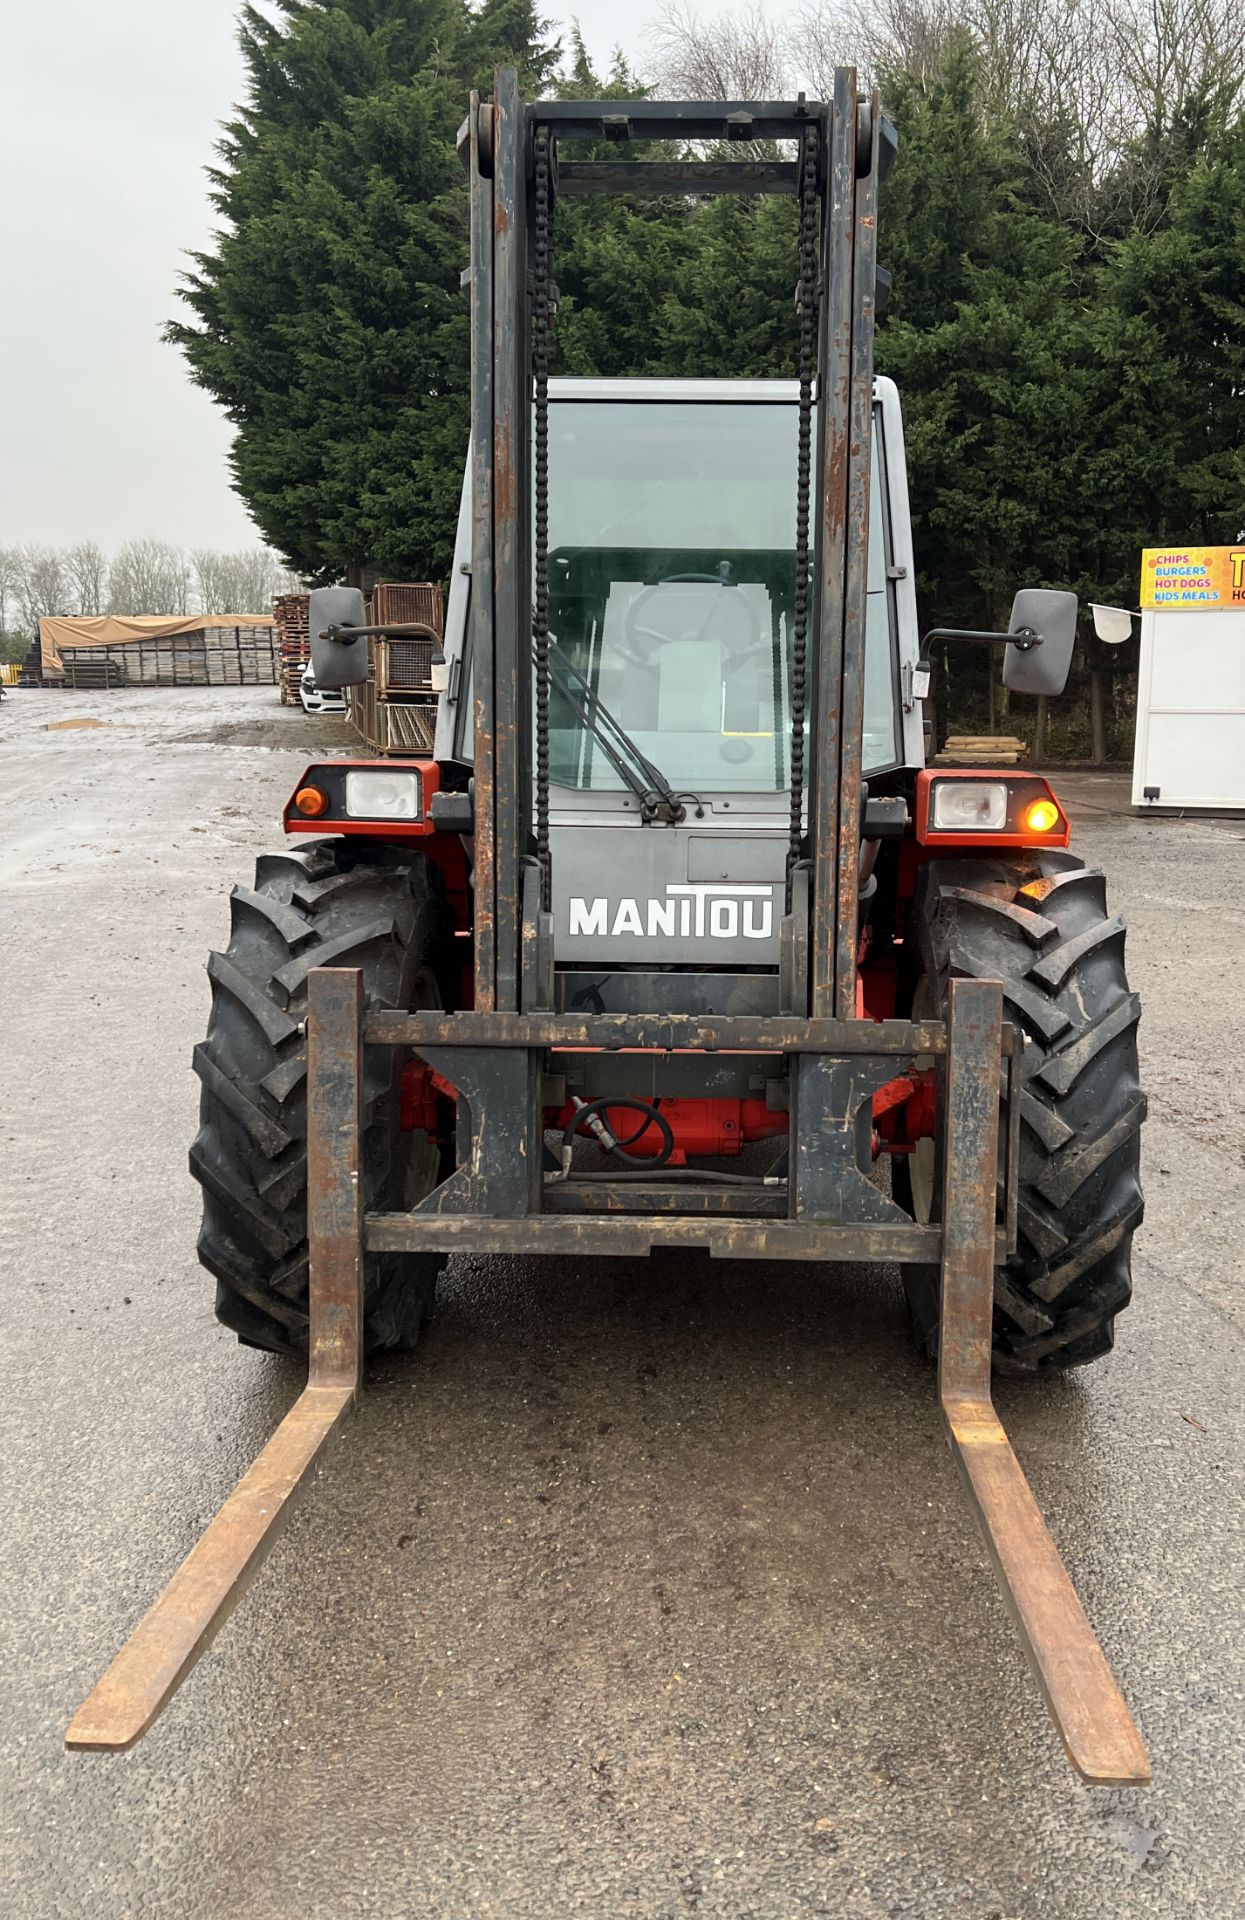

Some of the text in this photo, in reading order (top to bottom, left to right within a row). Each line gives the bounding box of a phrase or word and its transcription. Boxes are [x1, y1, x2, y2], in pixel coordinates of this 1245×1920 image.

[1156, 555, 1189, 564] CHIPS
[1156, 567, 1206, 576] BURGERS
[1155, 579, 1211, 588] HOT DOGS
[1154, 591, 1219, 601] KIDS MEALS
[569, 884, 773, 938] MANITOU
